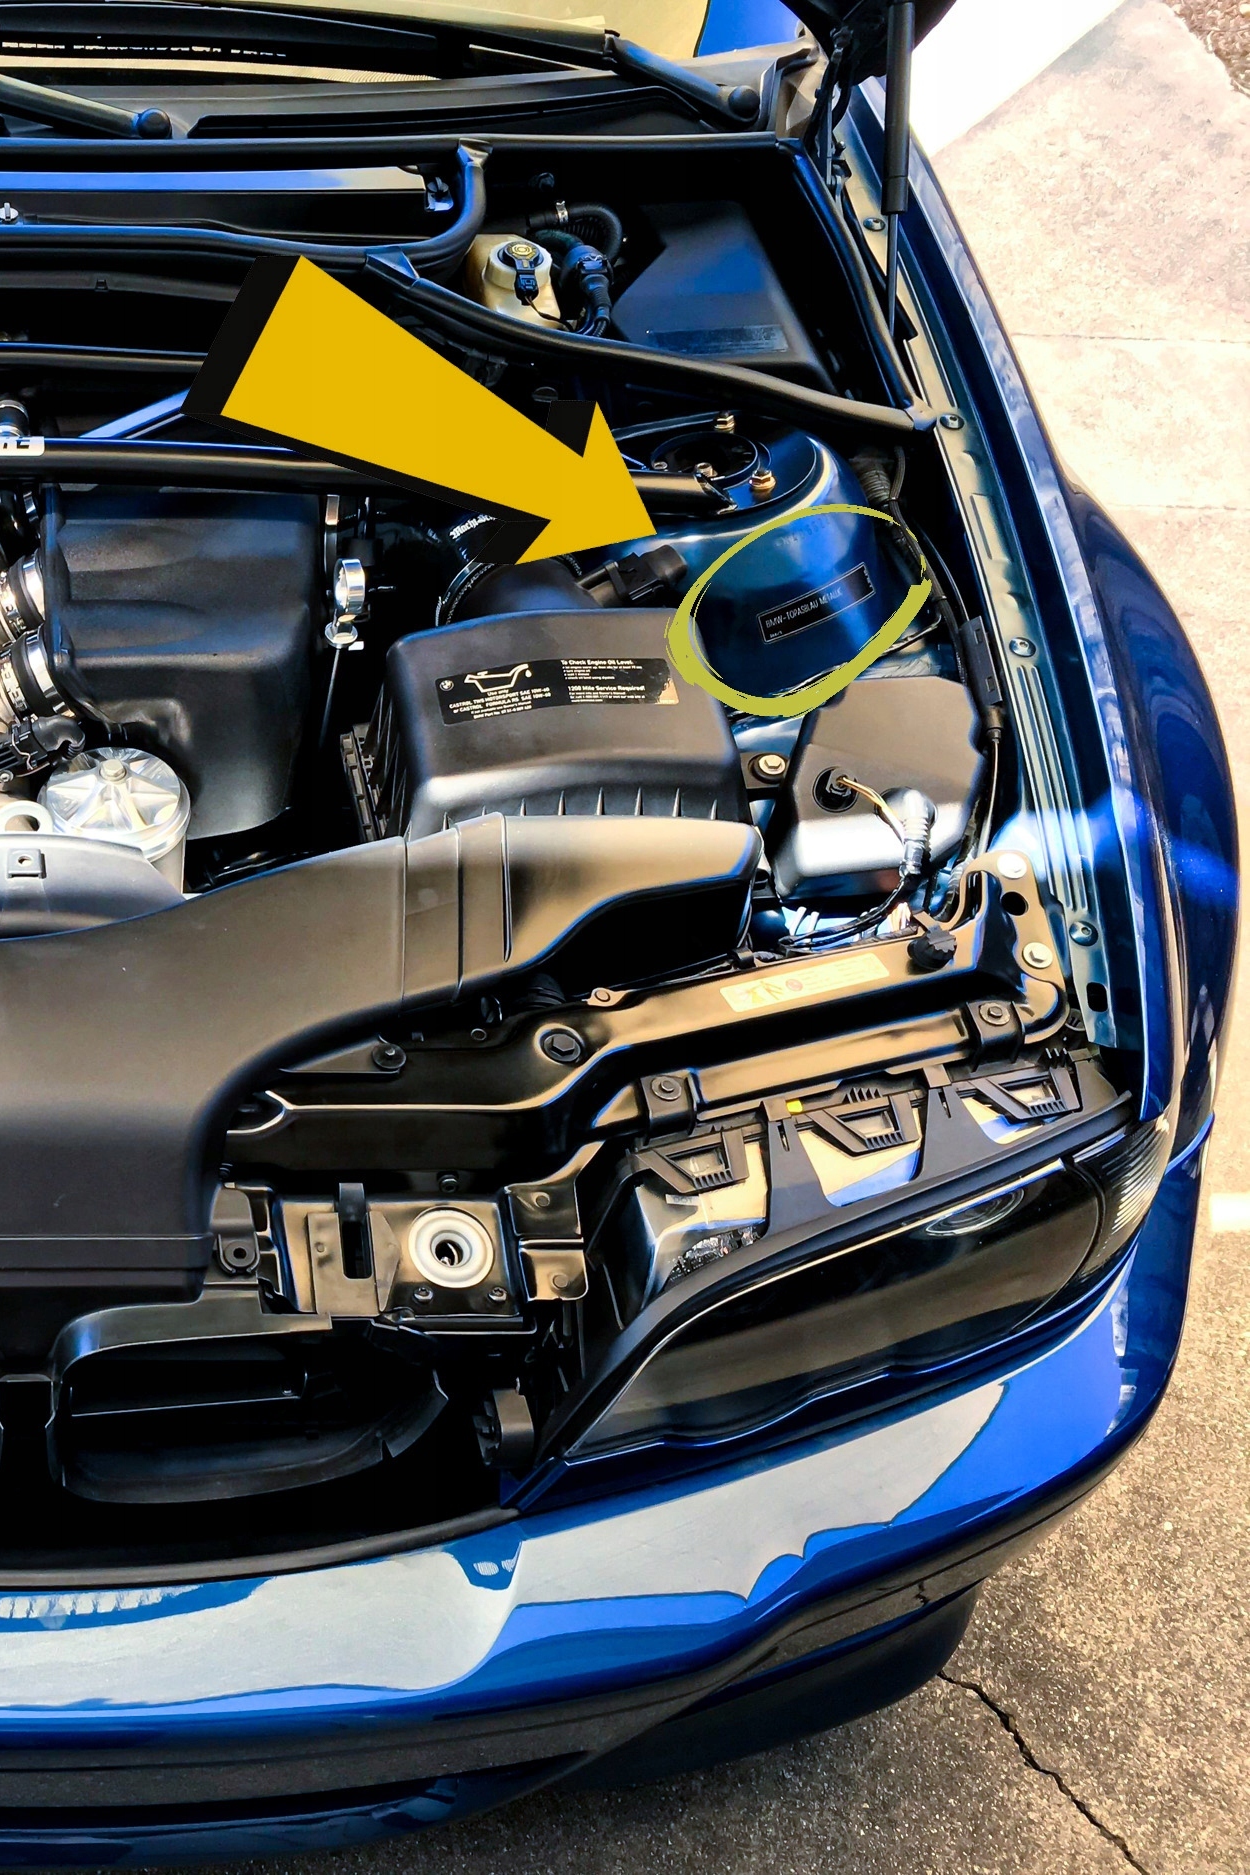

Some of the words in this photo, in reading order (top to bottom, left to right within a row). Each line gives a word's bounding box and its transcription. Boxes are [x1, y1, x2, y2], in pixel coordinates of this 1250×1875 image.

[449, 700, 473, 709] CASTROL
[484, 691, 519, 702] MOTORSPORT
[459, 704, 483, 712] CASTROL
[485, 698, 512, 707] FORMULA
